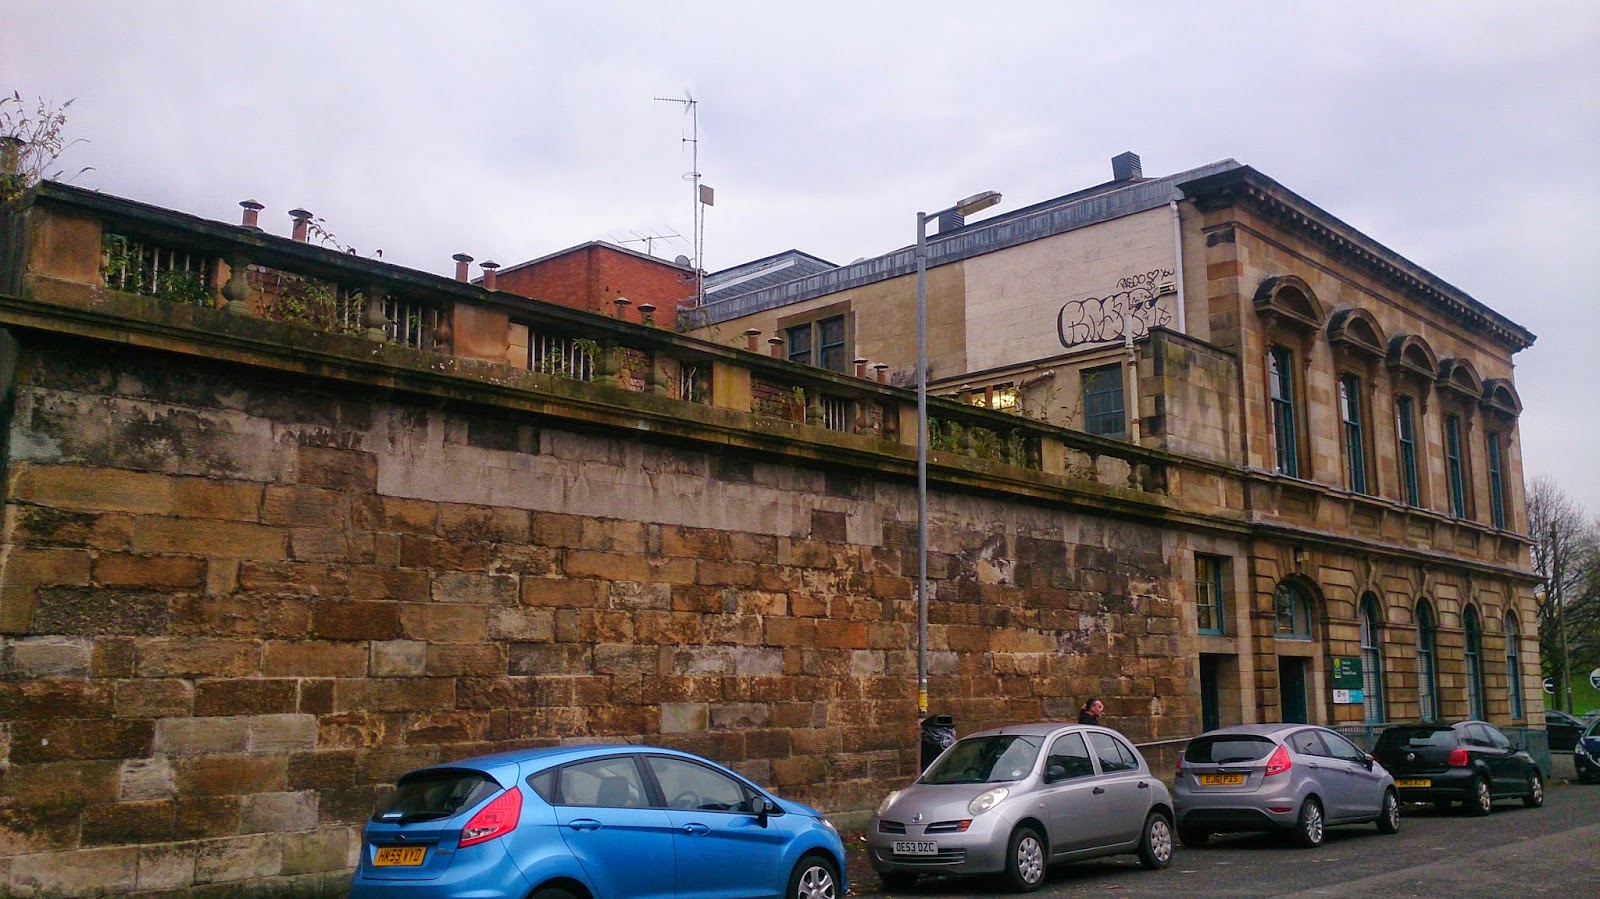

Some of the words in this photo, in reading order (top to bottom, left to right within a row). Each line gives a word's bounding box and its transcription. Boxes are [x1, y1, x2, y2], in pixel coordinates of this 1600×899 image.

[917, 842, 934, 852] DZC
[377, 849, 402, 863] HK59
[403, 848, 422, 862] VYD
